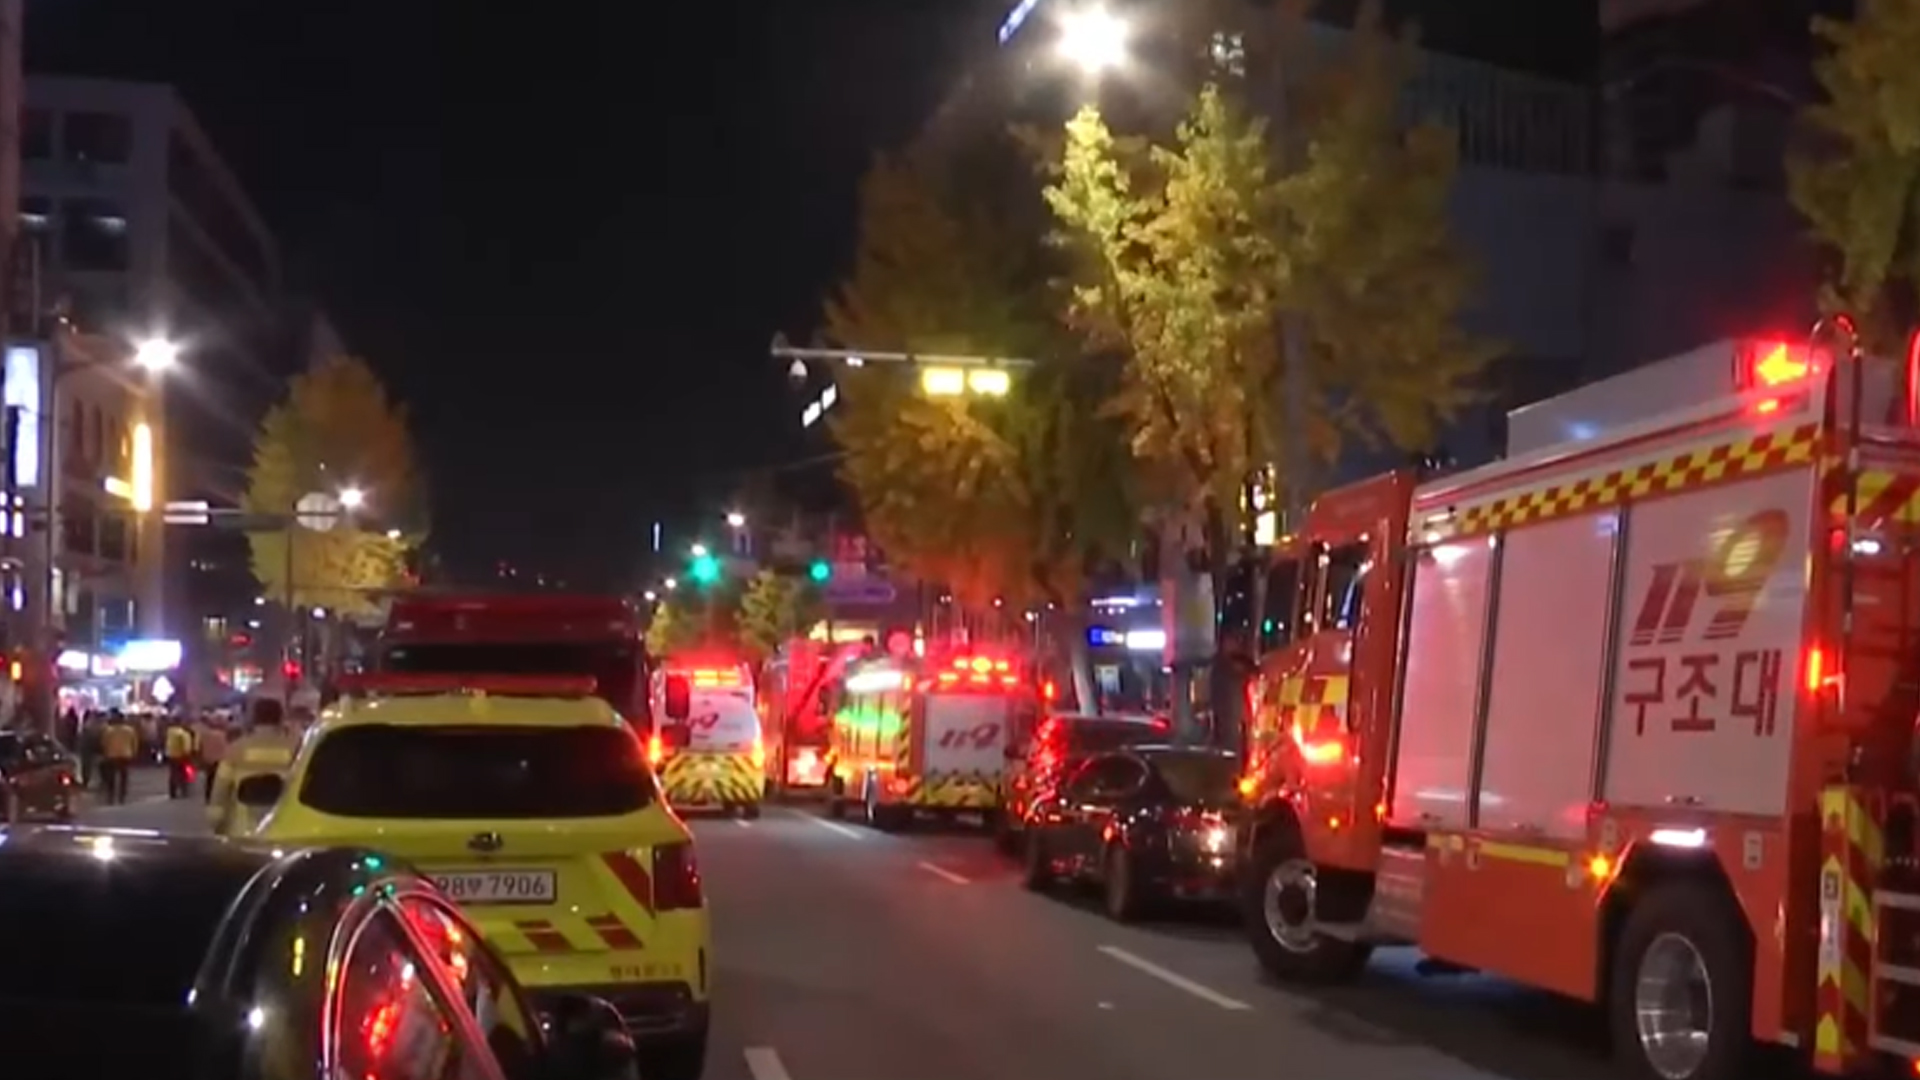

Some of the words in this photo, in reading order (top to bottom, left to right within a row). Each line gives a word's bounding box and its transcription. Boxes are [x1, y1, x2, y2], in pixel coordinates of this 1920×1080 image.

[1629, 508, 1788, 645] 119
[1625, 650, 1781, 737] 구조대
[939, 723, 999, 749] 119
[487, 874, 546, 896] 7906
